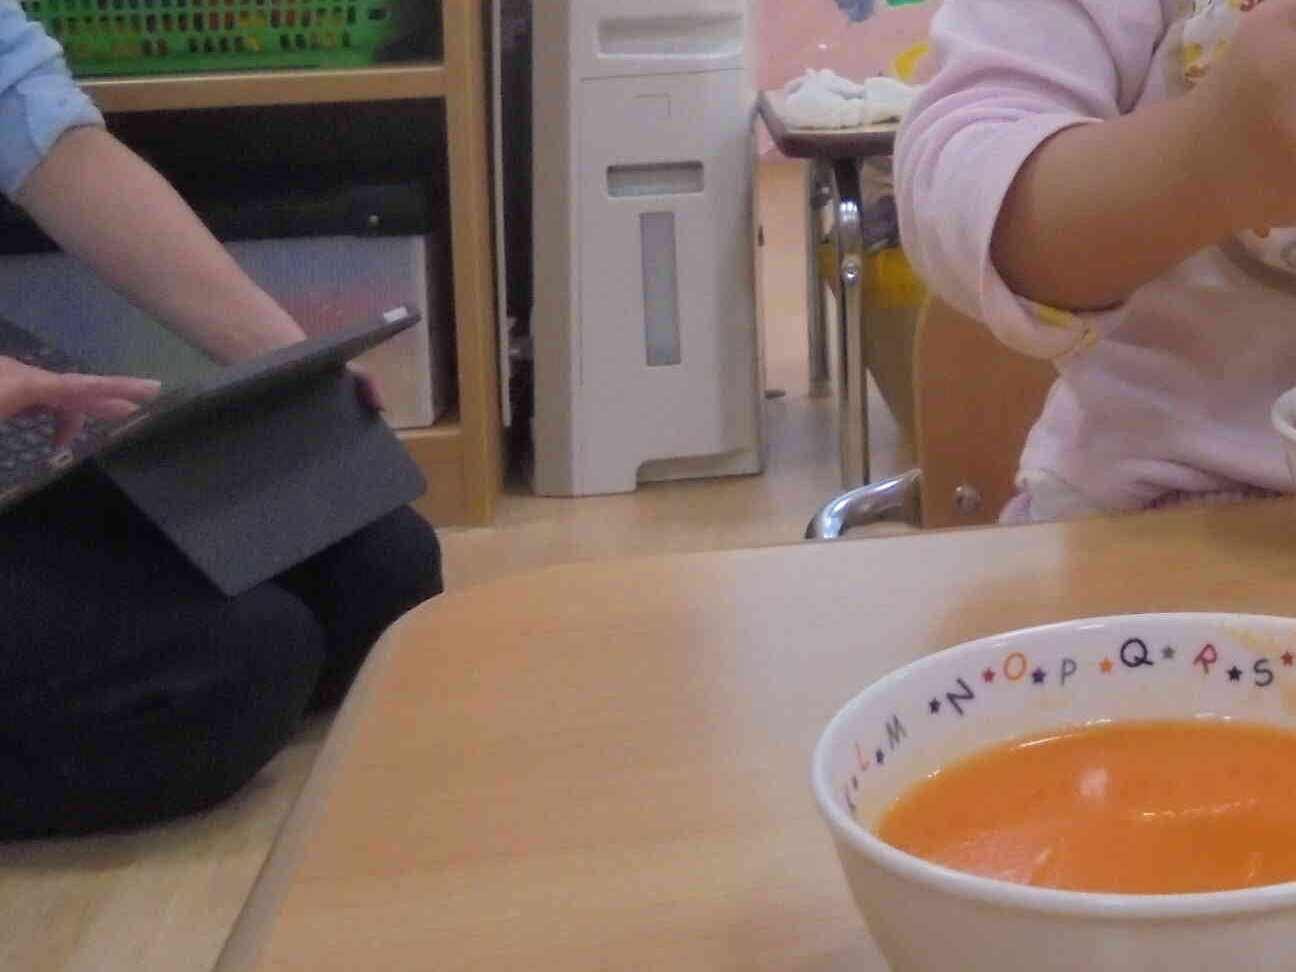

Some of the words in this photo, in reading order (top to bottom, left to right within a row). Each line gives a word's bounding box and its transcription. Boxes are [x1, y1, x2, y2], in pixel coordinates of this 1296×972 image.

[885, 714, 907, 749] M
[946, 678, 975, 716] N
[1003, 652, 1028, 681] O
[1060, 658, 1077, 685] P
[1120, 638, 1154, 668] Q
[1193, 644, 1218, 674] R
[1253, 658, 1275, 687] S
